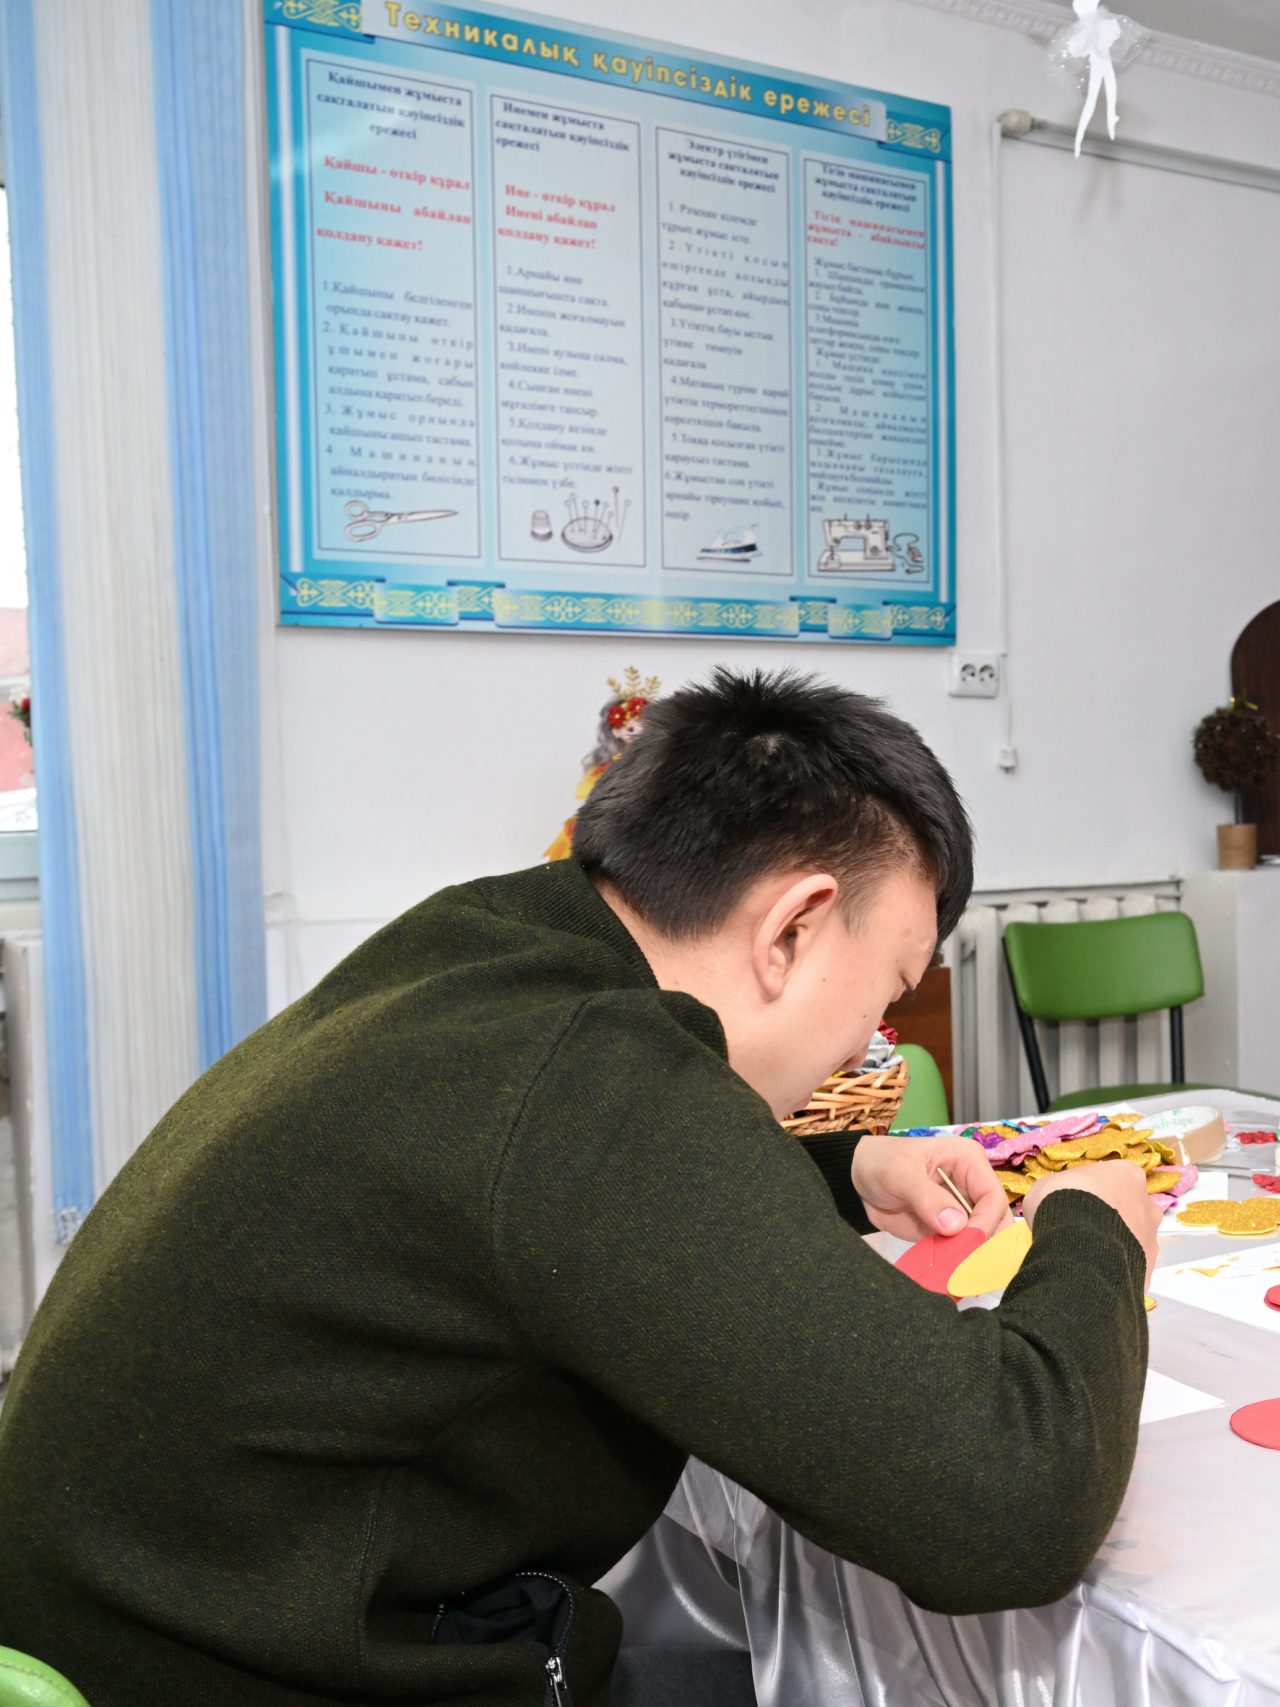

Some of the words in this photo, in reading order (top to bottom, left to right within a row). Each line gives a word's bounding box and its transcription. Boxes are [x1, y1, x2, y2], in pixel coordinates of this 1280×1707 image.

[385, 2, 580, 67] Техникалық
[592, 51, 752, 102] қауіпсіздік
[763, 89, 871, 127] ережесі
[328, 70, 401, 95] Қайшымен
[405, 88, 461, 108] жұмыста
[369, 121, 416, 142] ережесі
[552, 113, 604, 132] жұмыста
[324, 154, 377, 178] Қайшы
[389, 166, 426, 185] өткір
[324, 189, 401, 216] Қайшыны
[413, 204, 471, 224] абайлап
